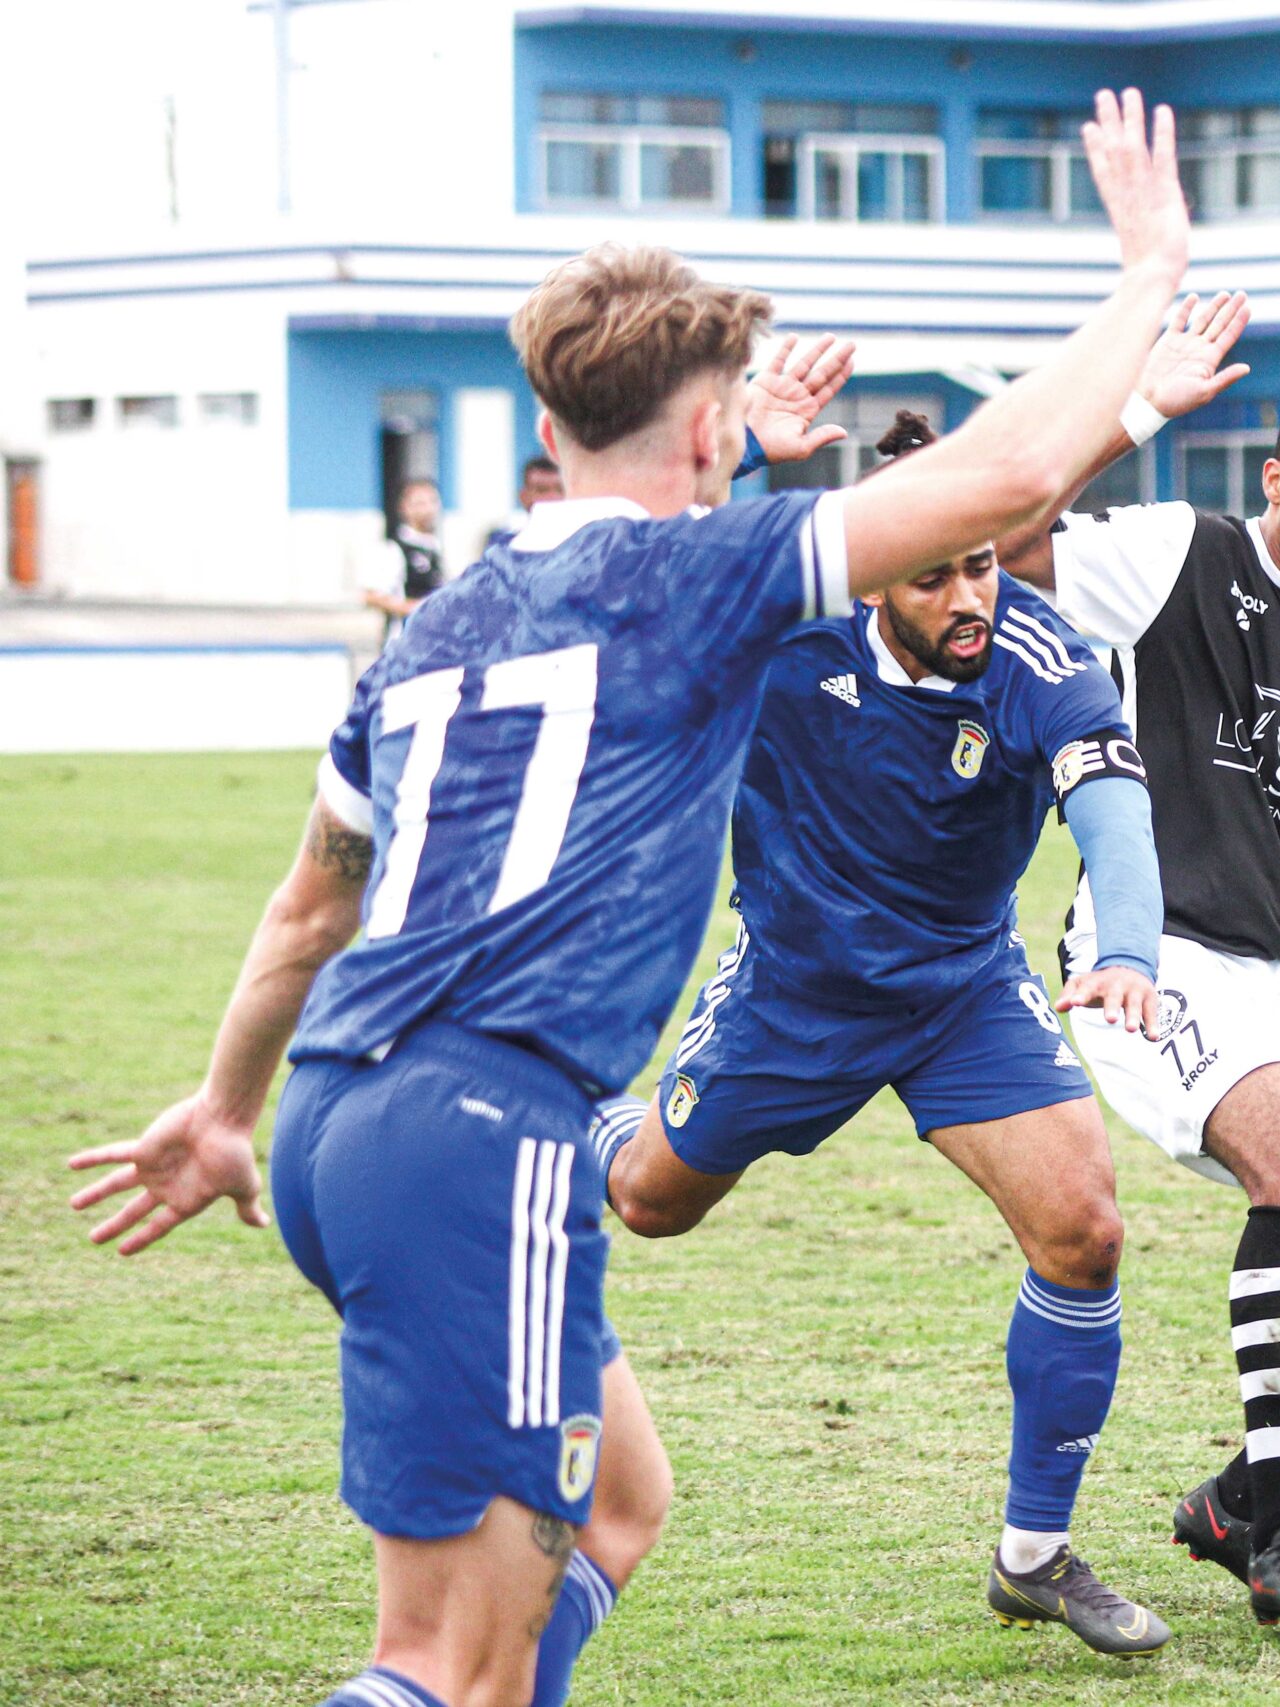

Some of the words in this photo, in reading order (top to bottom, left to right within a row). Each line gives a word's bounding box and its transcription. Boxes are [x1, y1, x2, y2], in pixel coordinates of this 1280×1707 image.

[819, 680, 862, 708] adidas
[1018, 981, 1063, 1035] 8
[1160, 1019, 1204, 1078] 77
